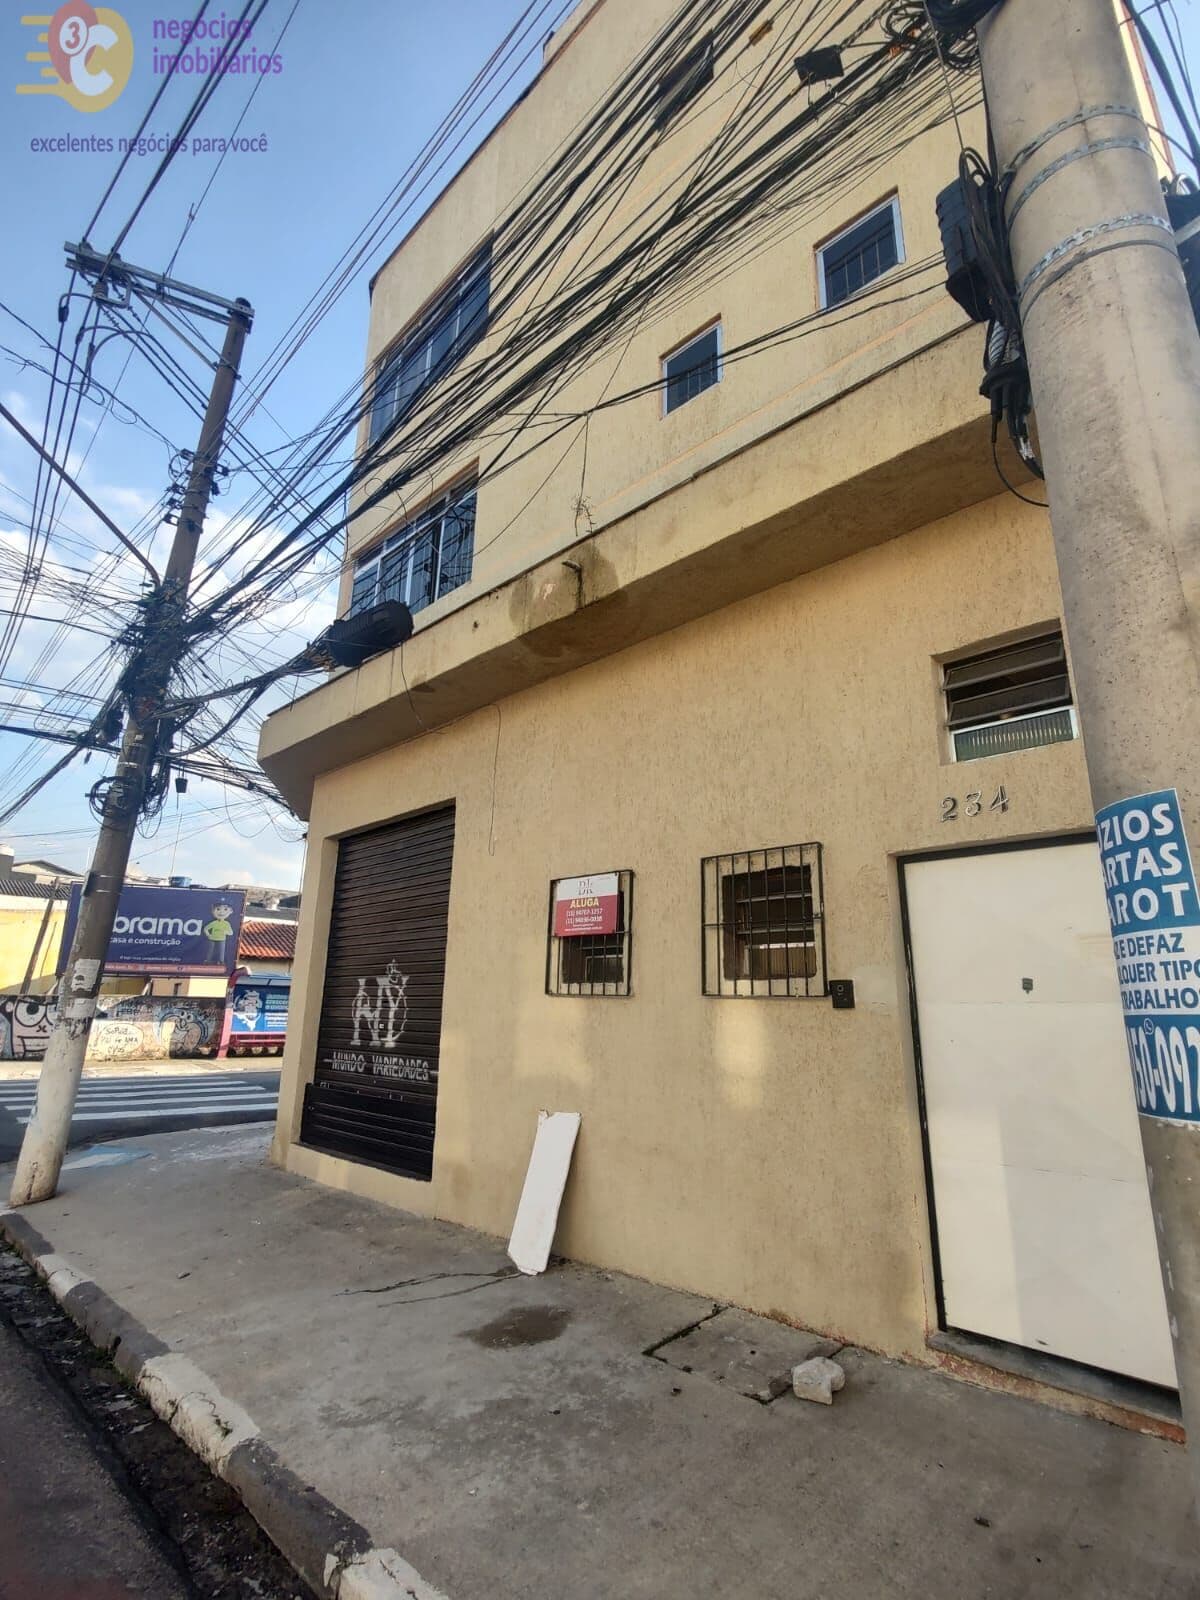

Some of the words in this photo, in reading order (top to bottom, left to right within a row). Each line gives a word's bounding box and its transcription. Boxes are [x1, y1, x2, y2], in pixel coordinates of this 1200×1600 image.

[940, 785, 1008, 822] 234
[570, 898, 599, 909] ALUGA
[134, 938, 181, 946] construção
[1126, 932, 1185, 957] DEFAZ
[332, 1052, 364, 1072] MUNDO
[372, 1056, 429, 1081] VARIEDADES
